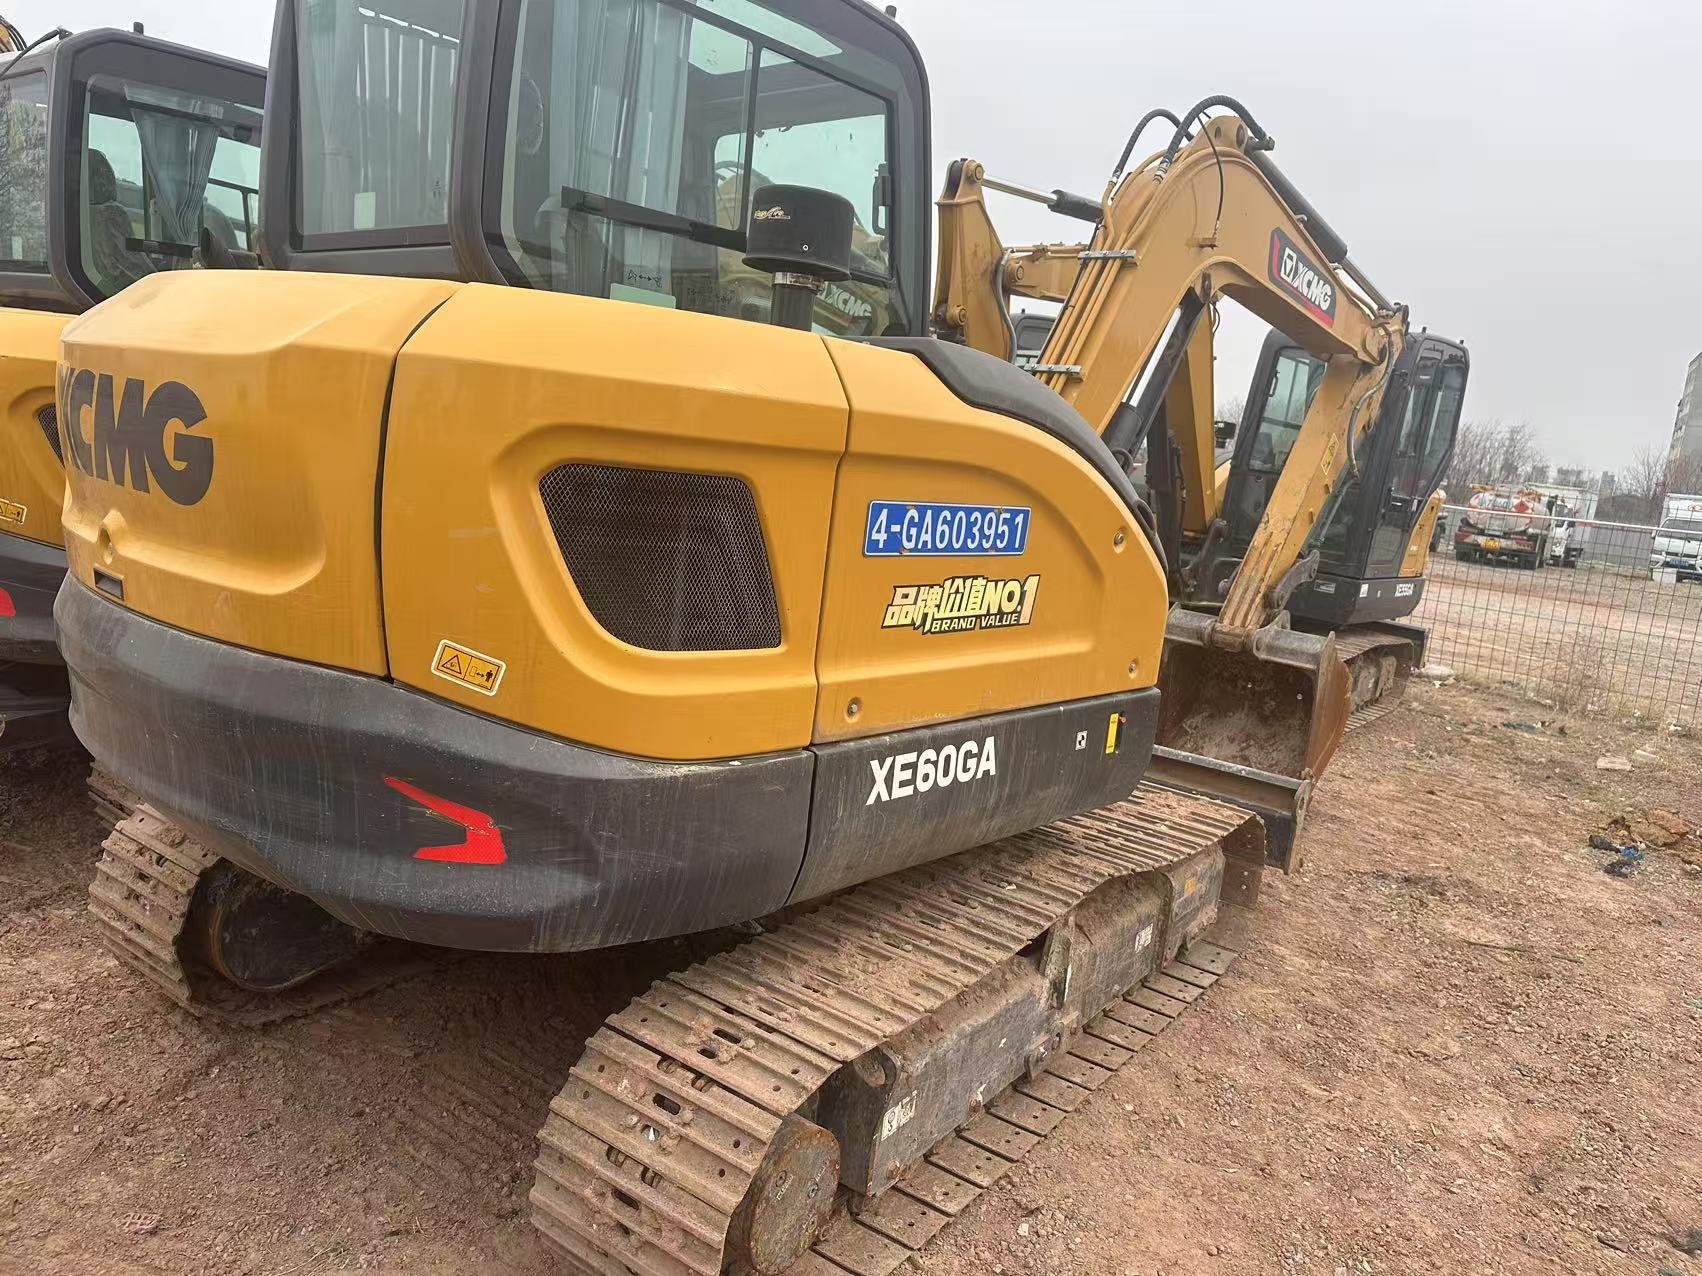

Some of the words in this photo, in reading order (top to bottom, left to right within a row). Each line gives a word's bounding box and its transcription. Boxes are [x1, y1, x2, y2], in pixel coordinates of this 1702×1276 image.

[826, 284, 872, 316] XCMG
[1292, 261, 1332, 311] XCMG
[871, 508, 1025, 549] 4-GA603951
[931, 619, 977, 632] BRAND
[980, 612, 1020, 628] VALUE
[865, 736, 996, 806] XE60GA
